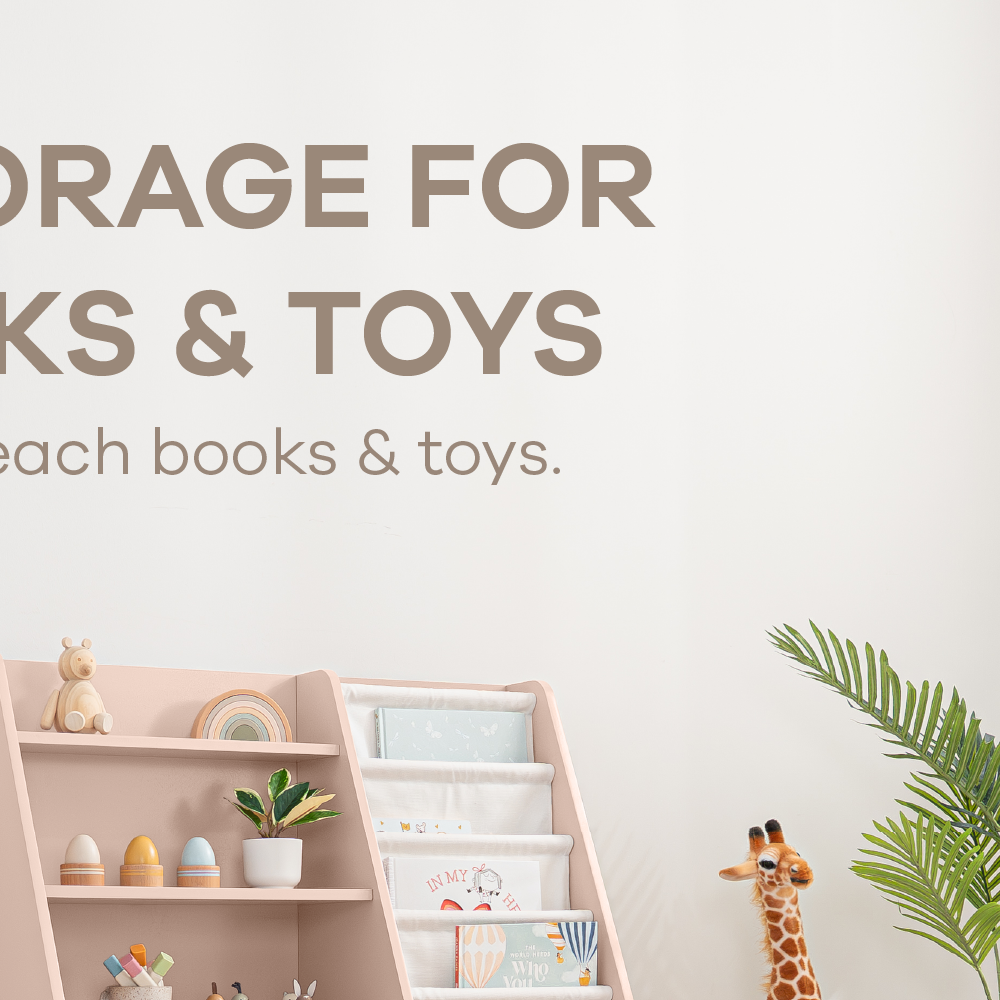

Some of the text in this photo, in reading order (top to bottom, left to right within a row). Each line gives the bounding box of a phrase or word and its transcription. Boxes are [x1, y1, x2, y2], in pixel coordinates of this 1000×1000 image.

[426, 869, 468, 892] IN MY
[512, 961, 549, 983] Who
